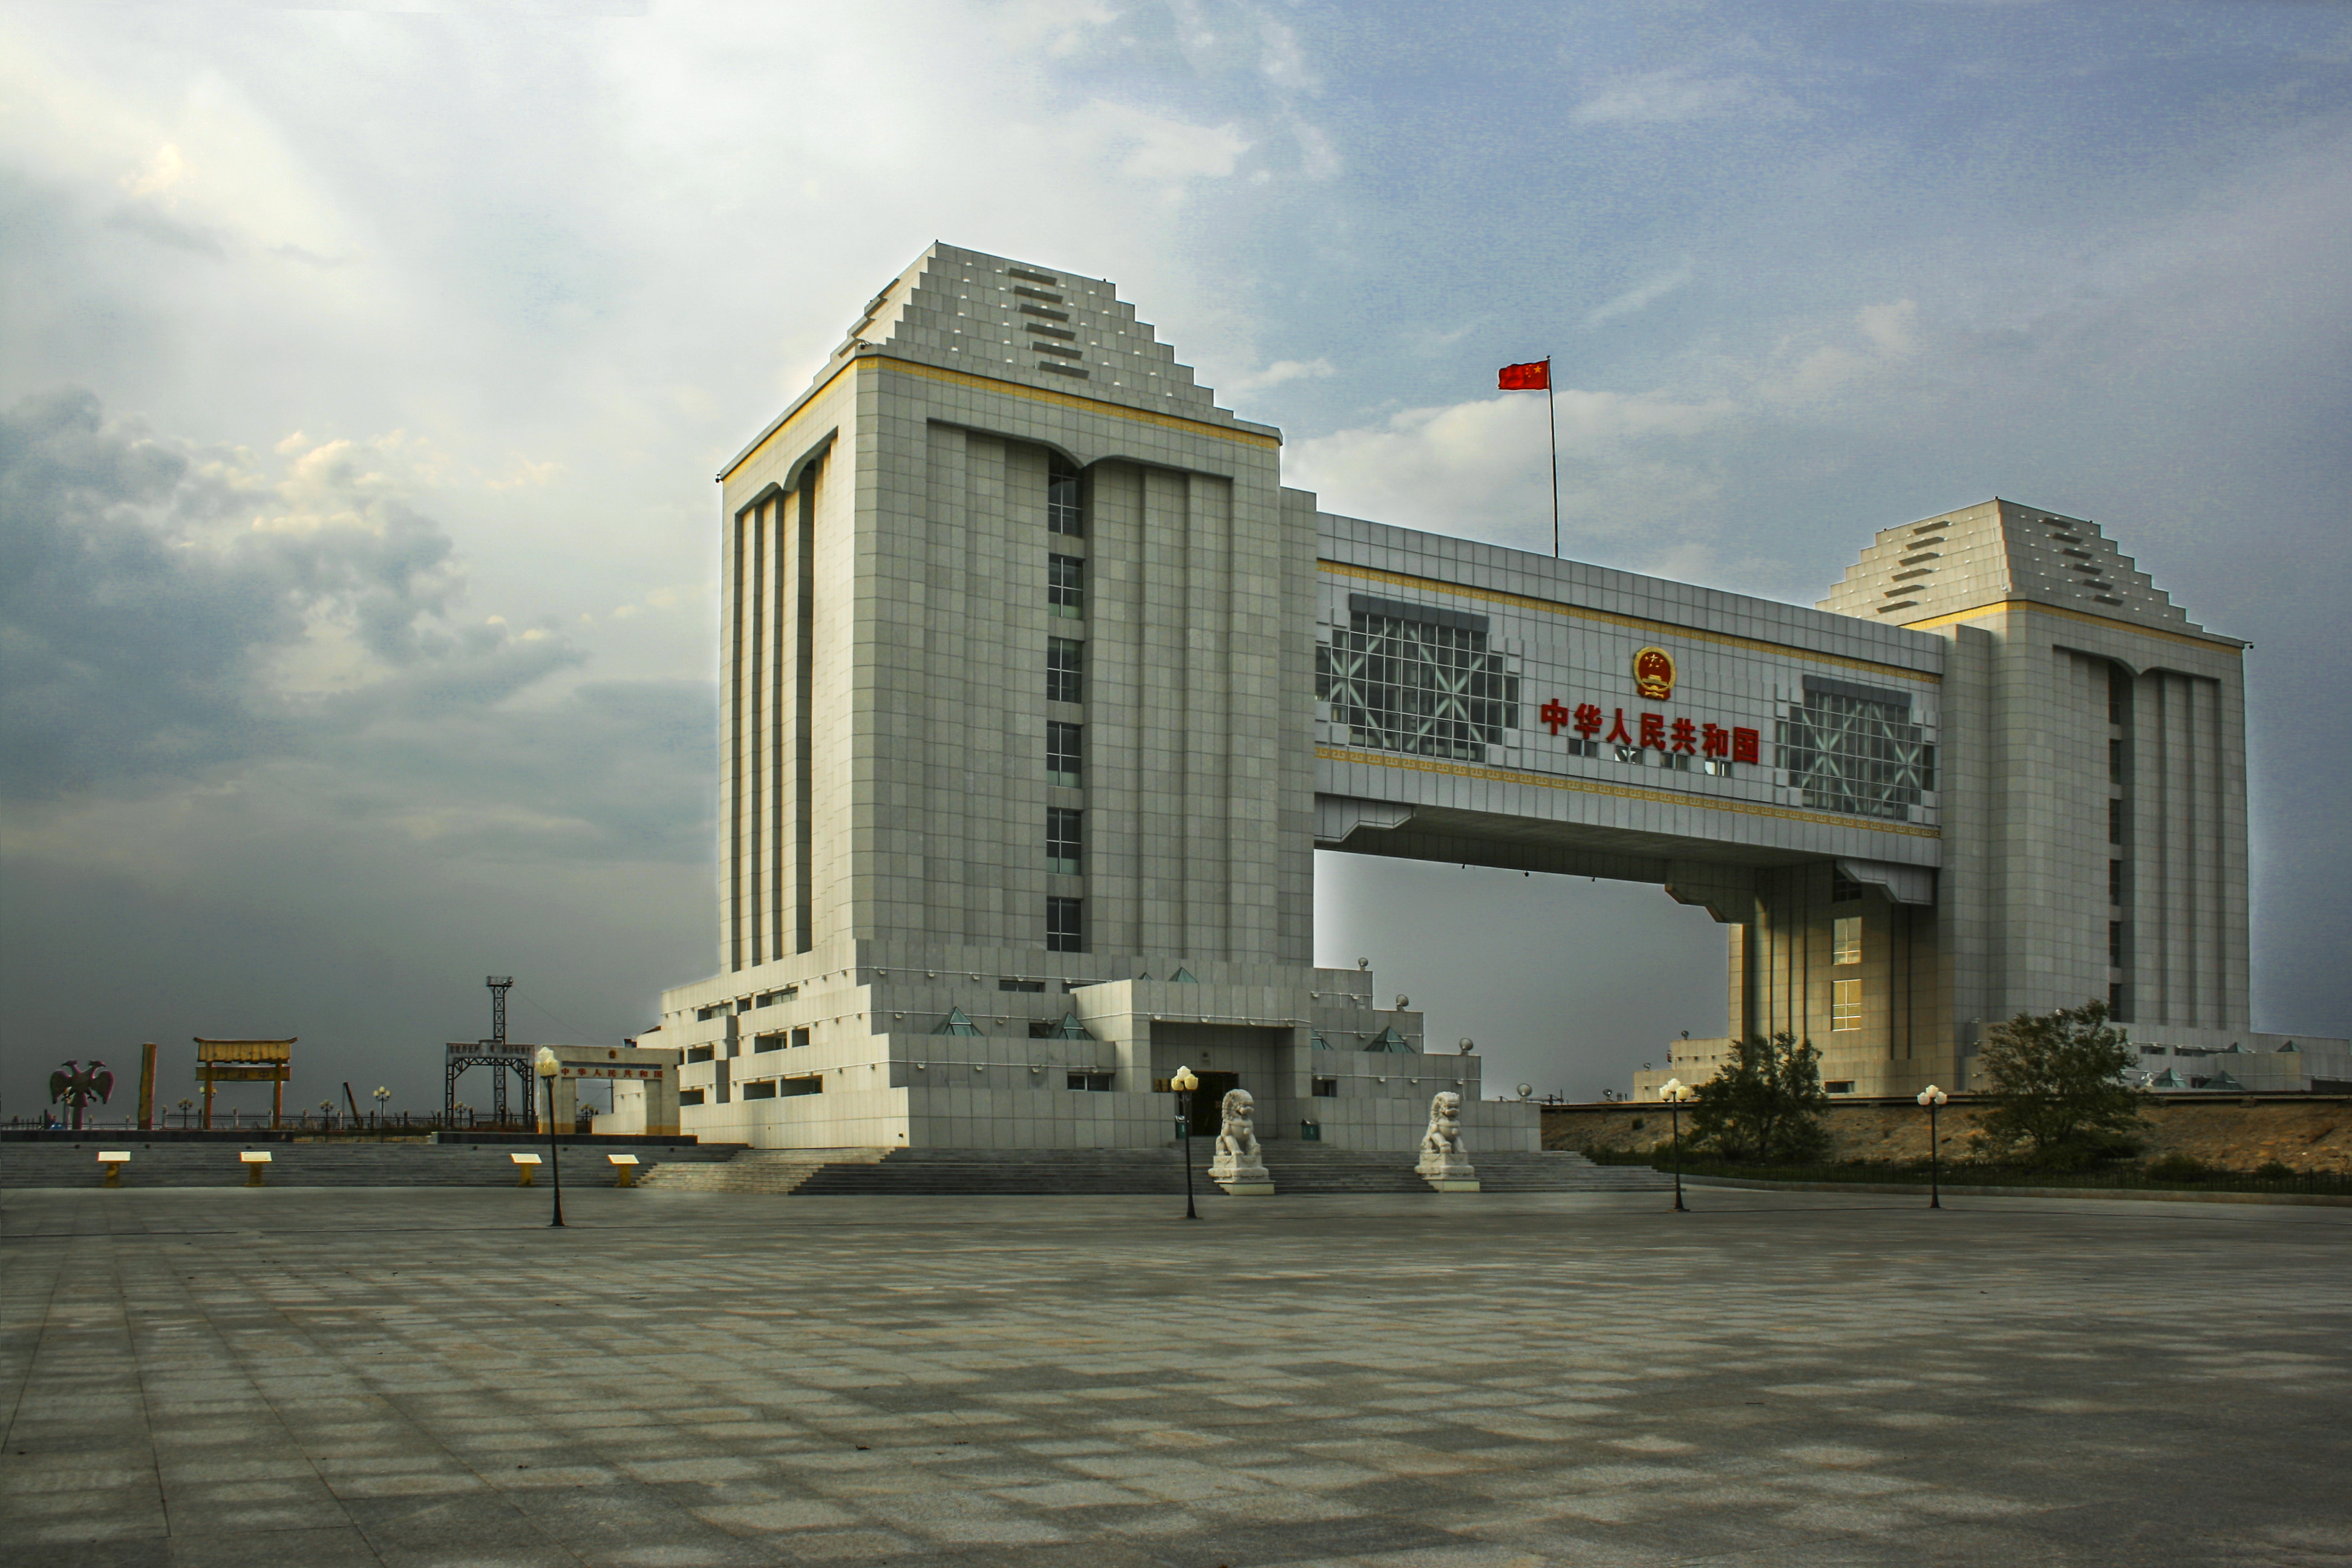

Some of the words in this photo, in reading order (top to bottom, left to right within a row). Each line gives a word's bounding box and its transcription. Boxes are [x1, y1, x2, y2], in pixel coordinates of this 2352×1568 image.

[1541, 698, 1759, 765] 中华人民共和国
[561, 1067, 664, 1079] 中华人民共和国
